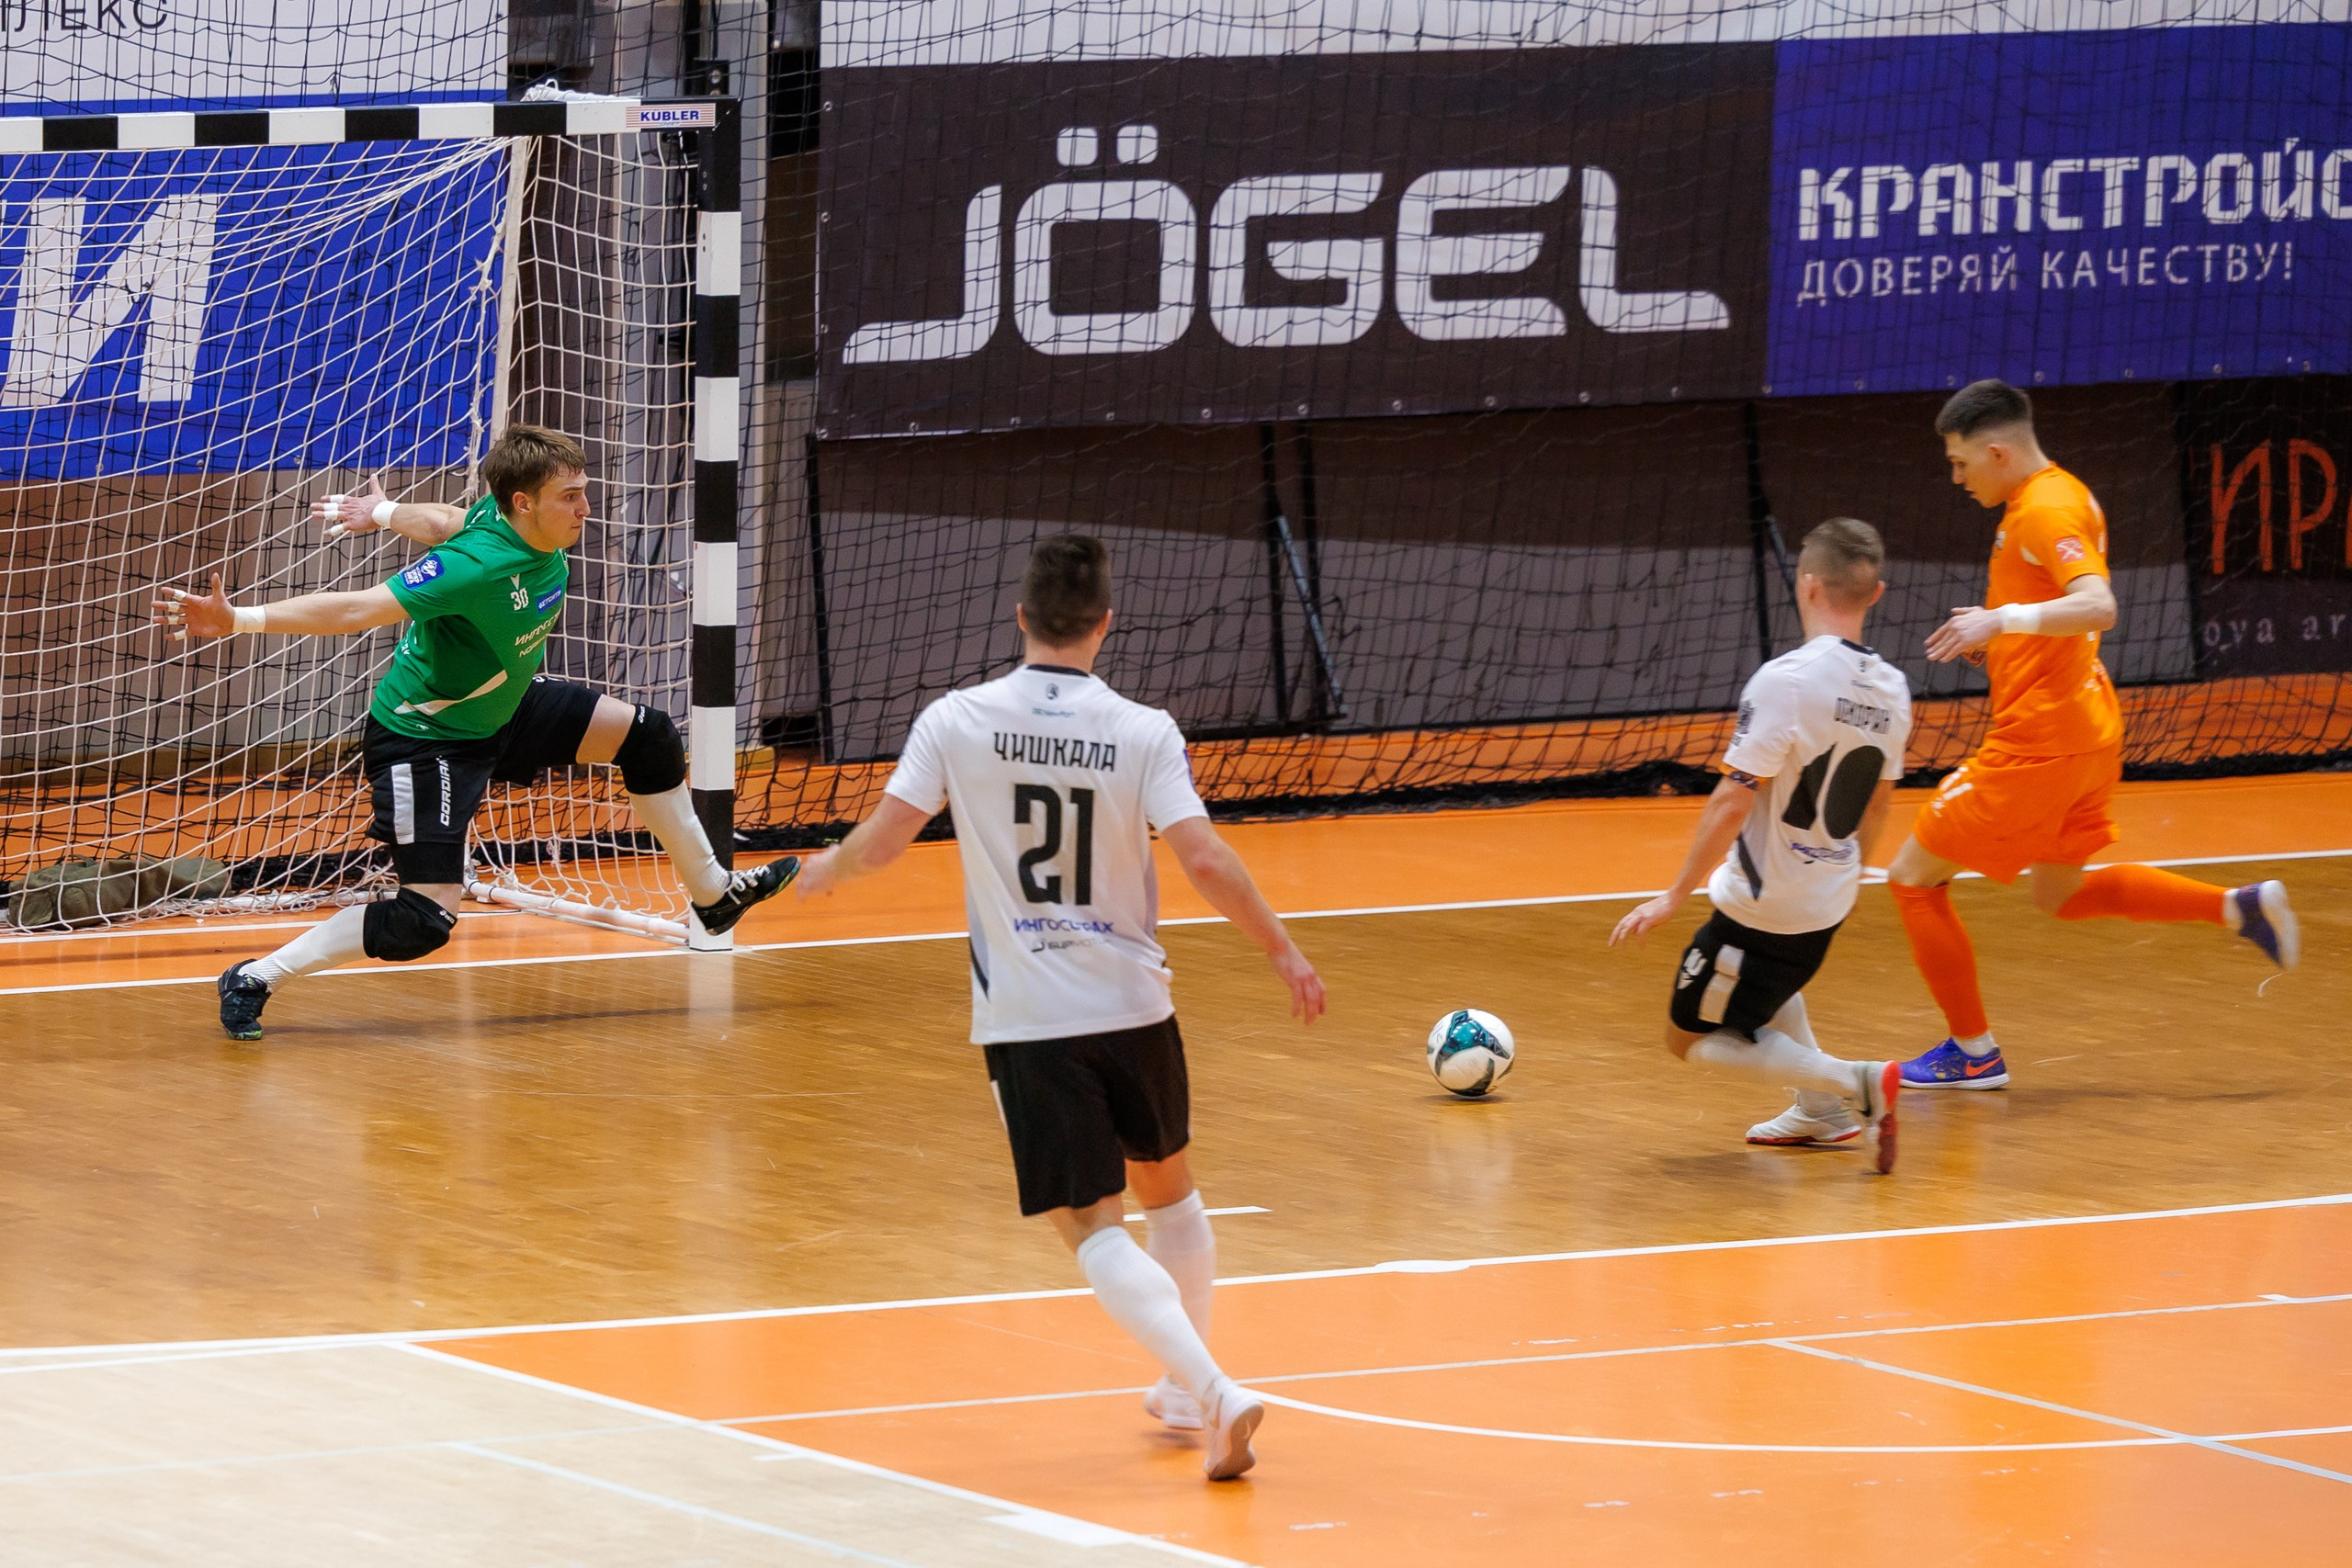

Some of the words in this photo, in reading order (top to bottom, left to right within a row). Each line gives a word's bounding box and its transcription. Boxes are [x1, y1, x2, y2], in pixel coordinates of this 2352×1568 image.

[640, 109, 699, 121] KÜBLER
[842, 124, 1731, 365] JÖGEL
[1796, 245, 2018, 308] ДОВЕРЯЙ
[2041, 242, 2295, 290] КАЧЕСТВУ!
[2210, 437, 2352, 575] ИР
[510, 587, 529, 612] 30
[993, 732, 1116, 773] ЧИШКАЛА
[1013, 784, 1094, 906] 21
